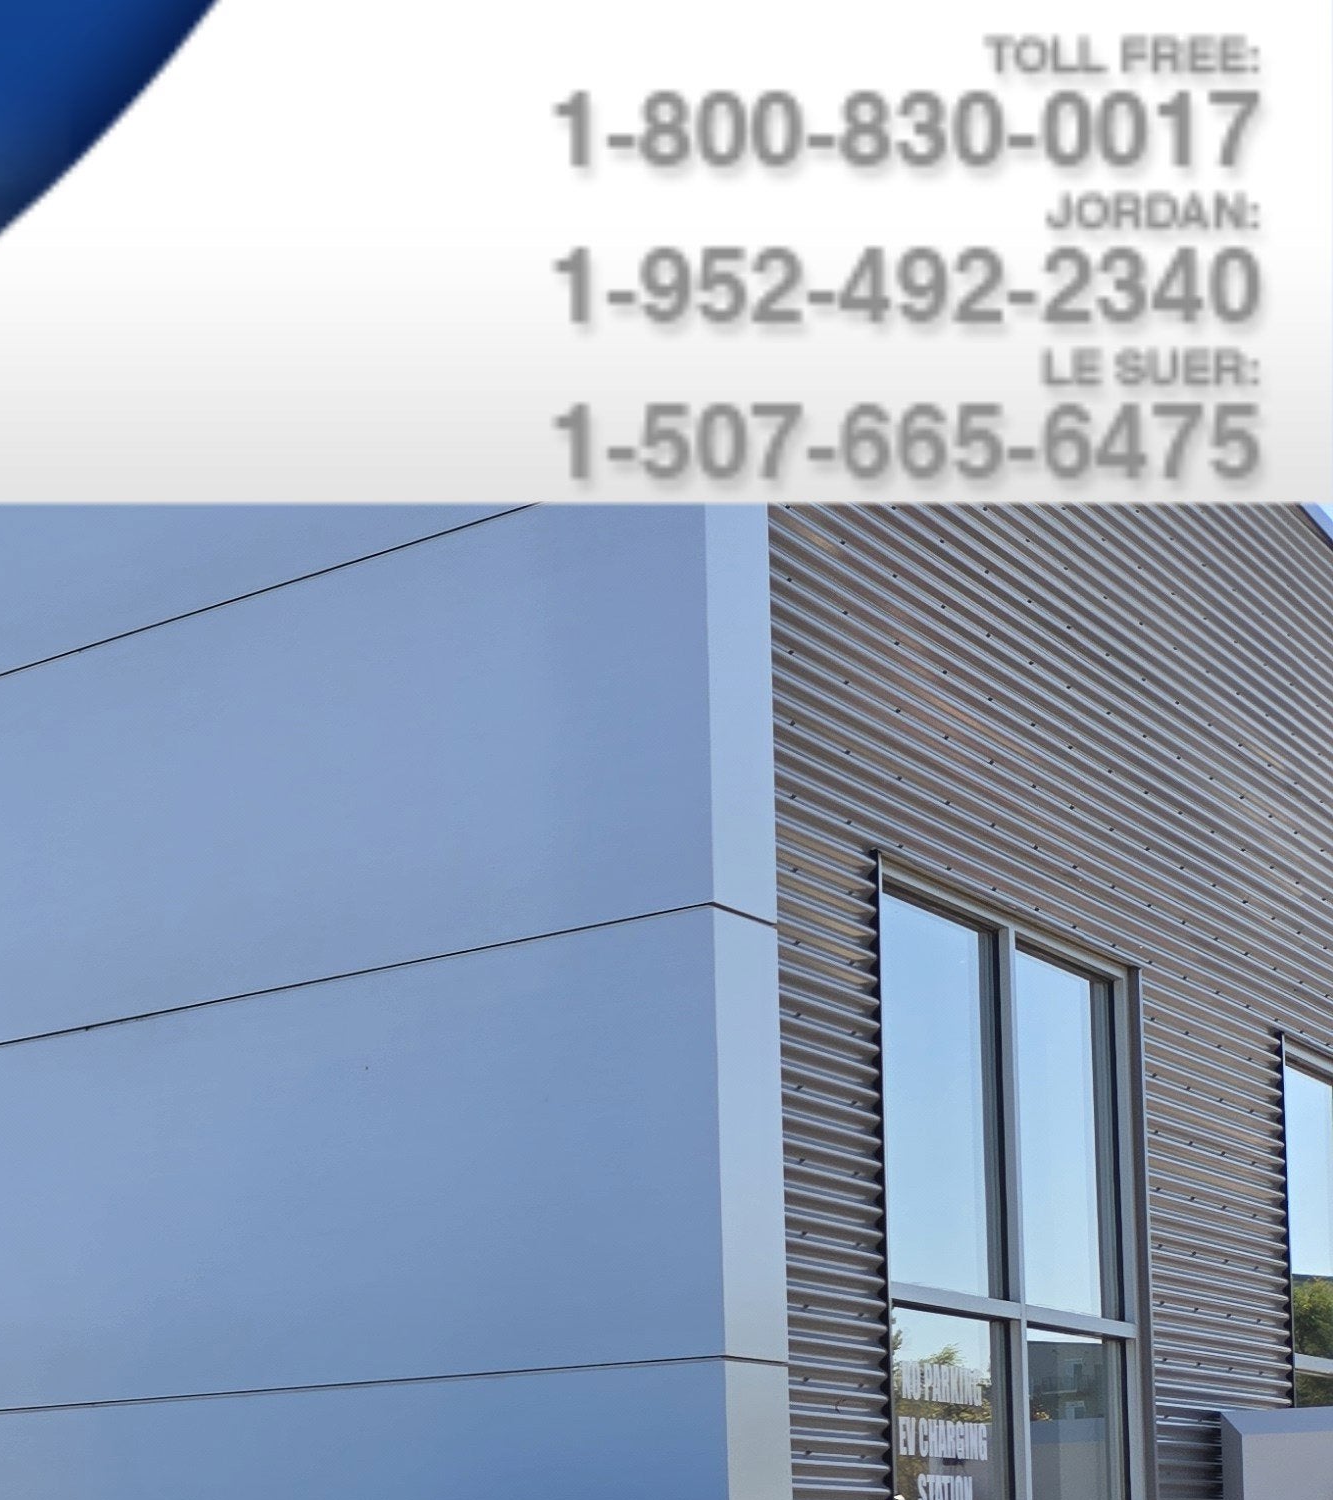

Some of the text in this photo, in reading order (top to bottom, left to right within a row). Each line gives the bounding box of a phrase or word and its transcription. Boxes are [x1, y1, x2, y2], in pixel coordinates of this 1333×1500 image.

[901, 1361, 982, 1407] NO PARKING
[898, 1416, 988, 1461] EV CHARGING
